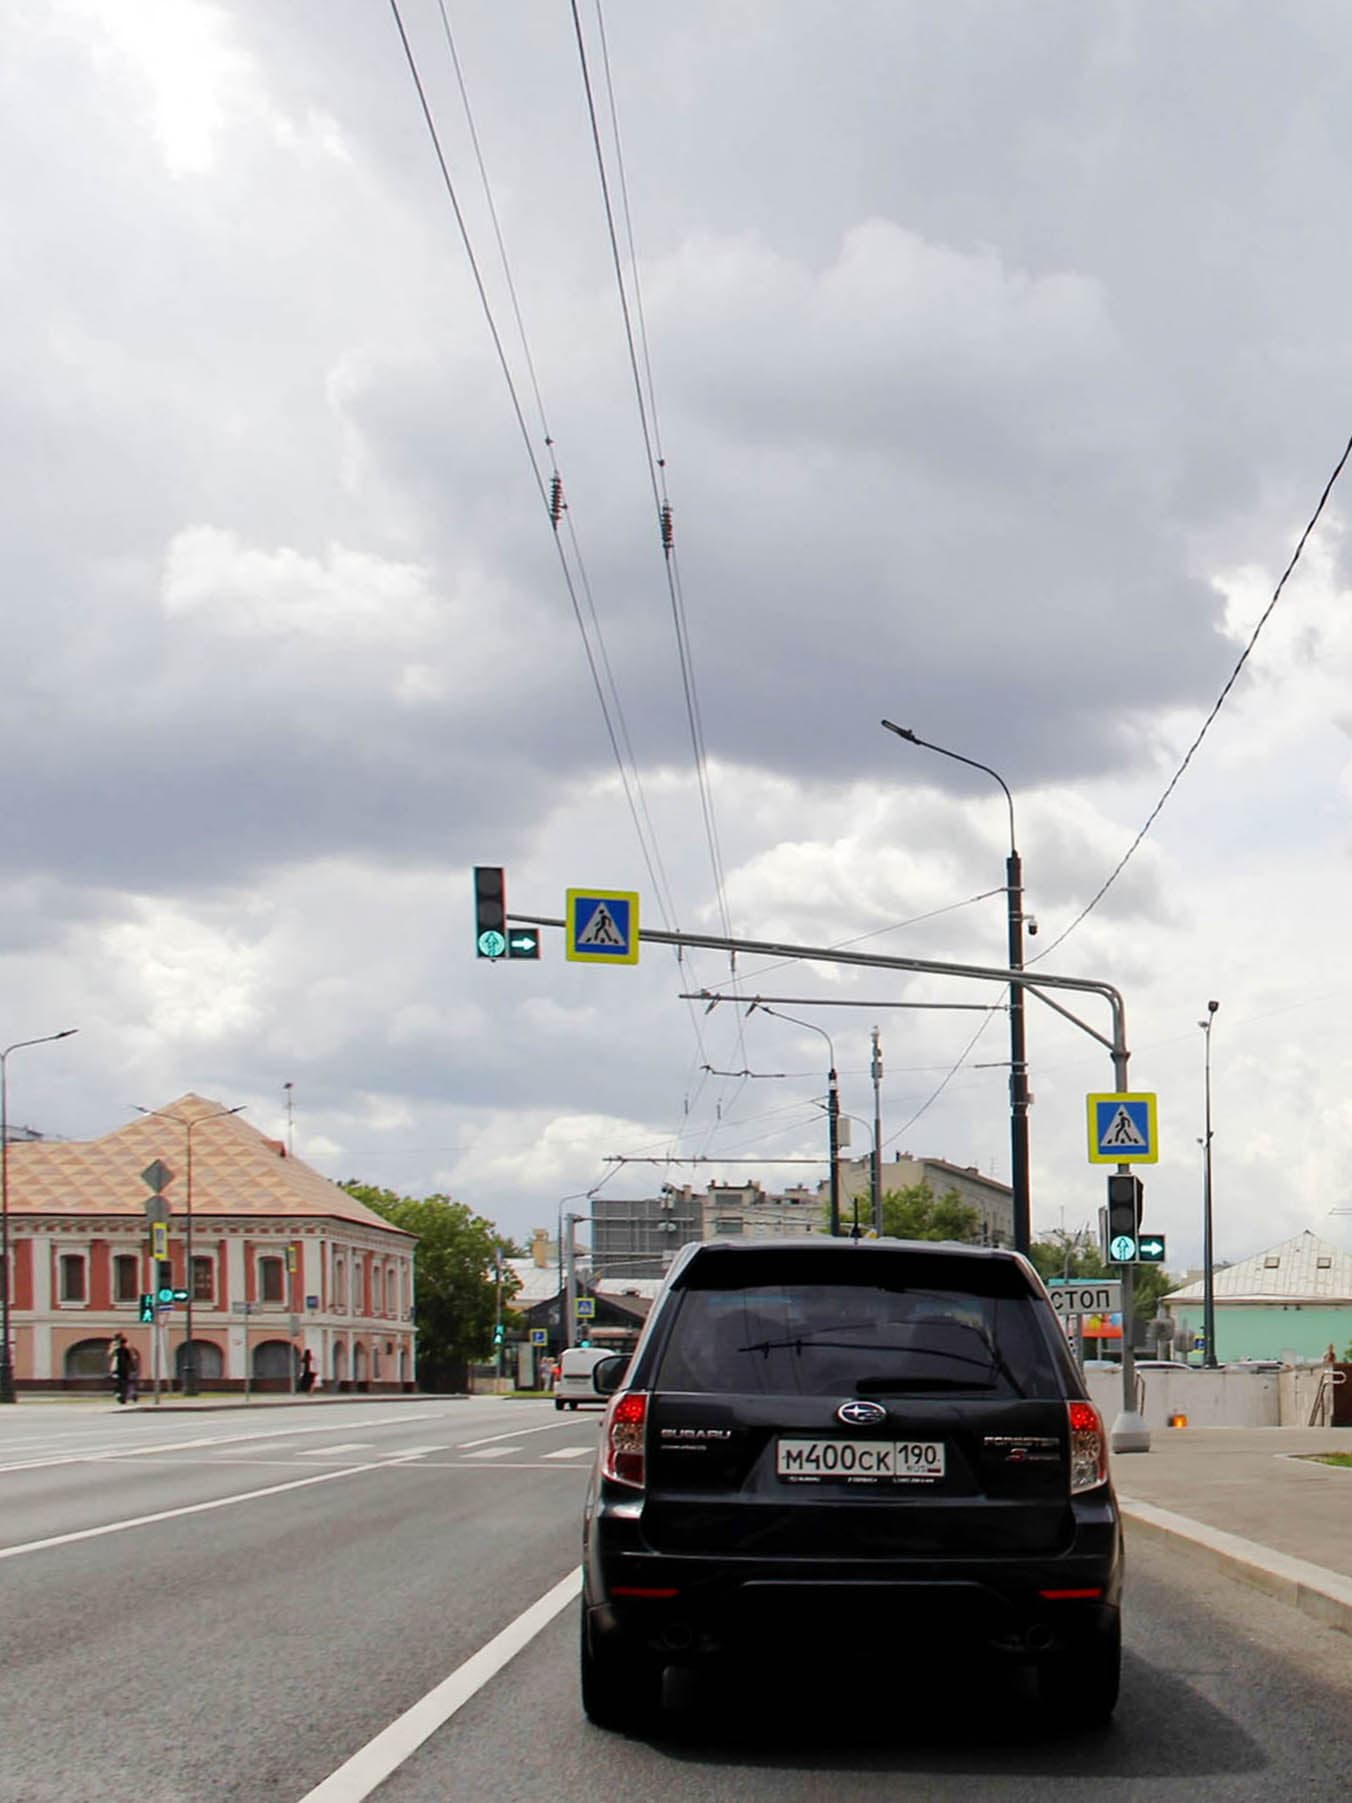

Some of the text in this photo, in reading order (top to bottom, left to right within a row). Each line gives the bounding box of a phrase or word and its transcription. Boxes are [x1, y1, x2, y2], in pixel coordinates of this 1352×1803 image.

[1051, 1289, 1110, 1310] СТОП
[660, 1428, 732, 1440] SUBARU
[898, 1444, 937, 1465] 190
